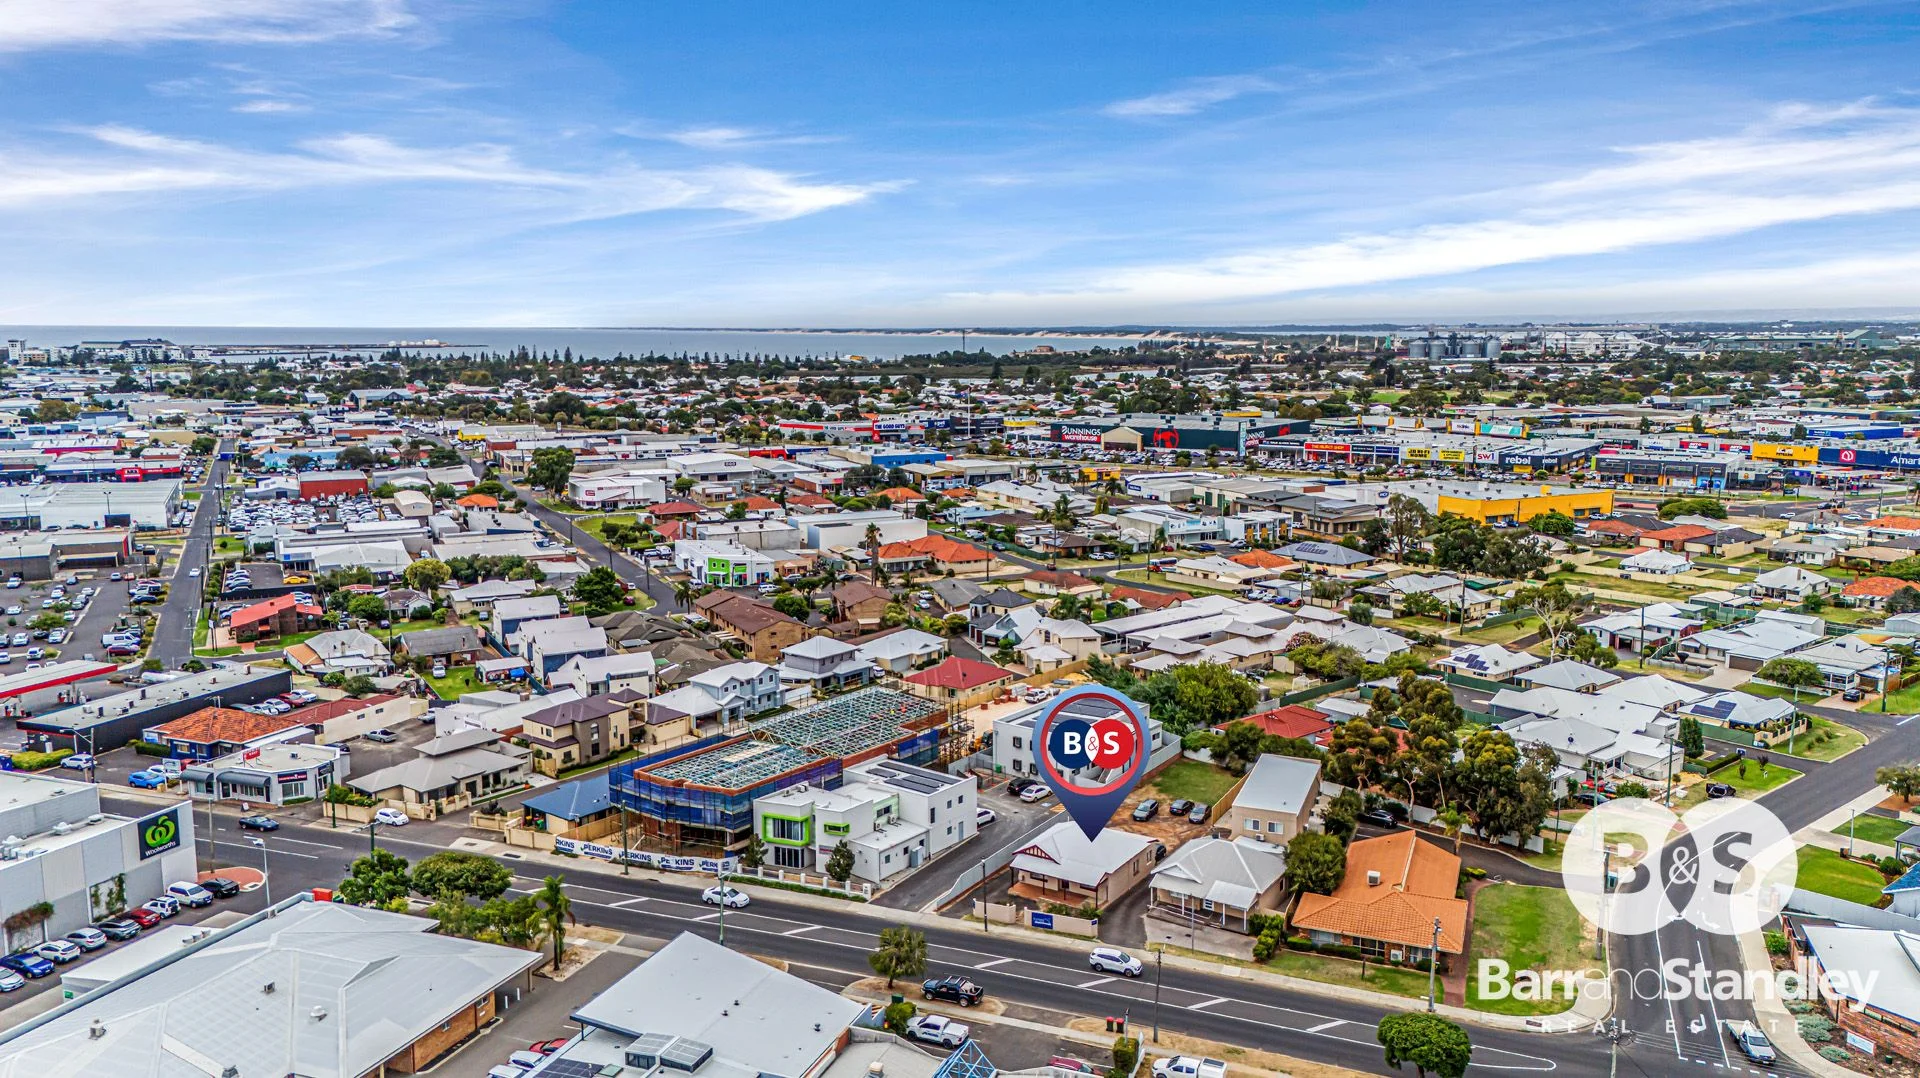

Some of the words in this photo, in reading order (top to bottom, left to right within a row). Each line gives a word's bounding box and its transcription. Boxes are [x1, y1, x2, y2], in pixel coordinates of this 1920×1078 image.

[1061, 425, 1101, 436] BUNNINGS
[1064, 434, 1098, 442] warehouse
[1505, 455, 1531, 465] rebel
[144, 841, 176, 857] Woolworths
[556, 838, 575, 849] RKINS
[583, 843, 613, 855] PERKINS
[660, 856, 695, 866] PEKINS
